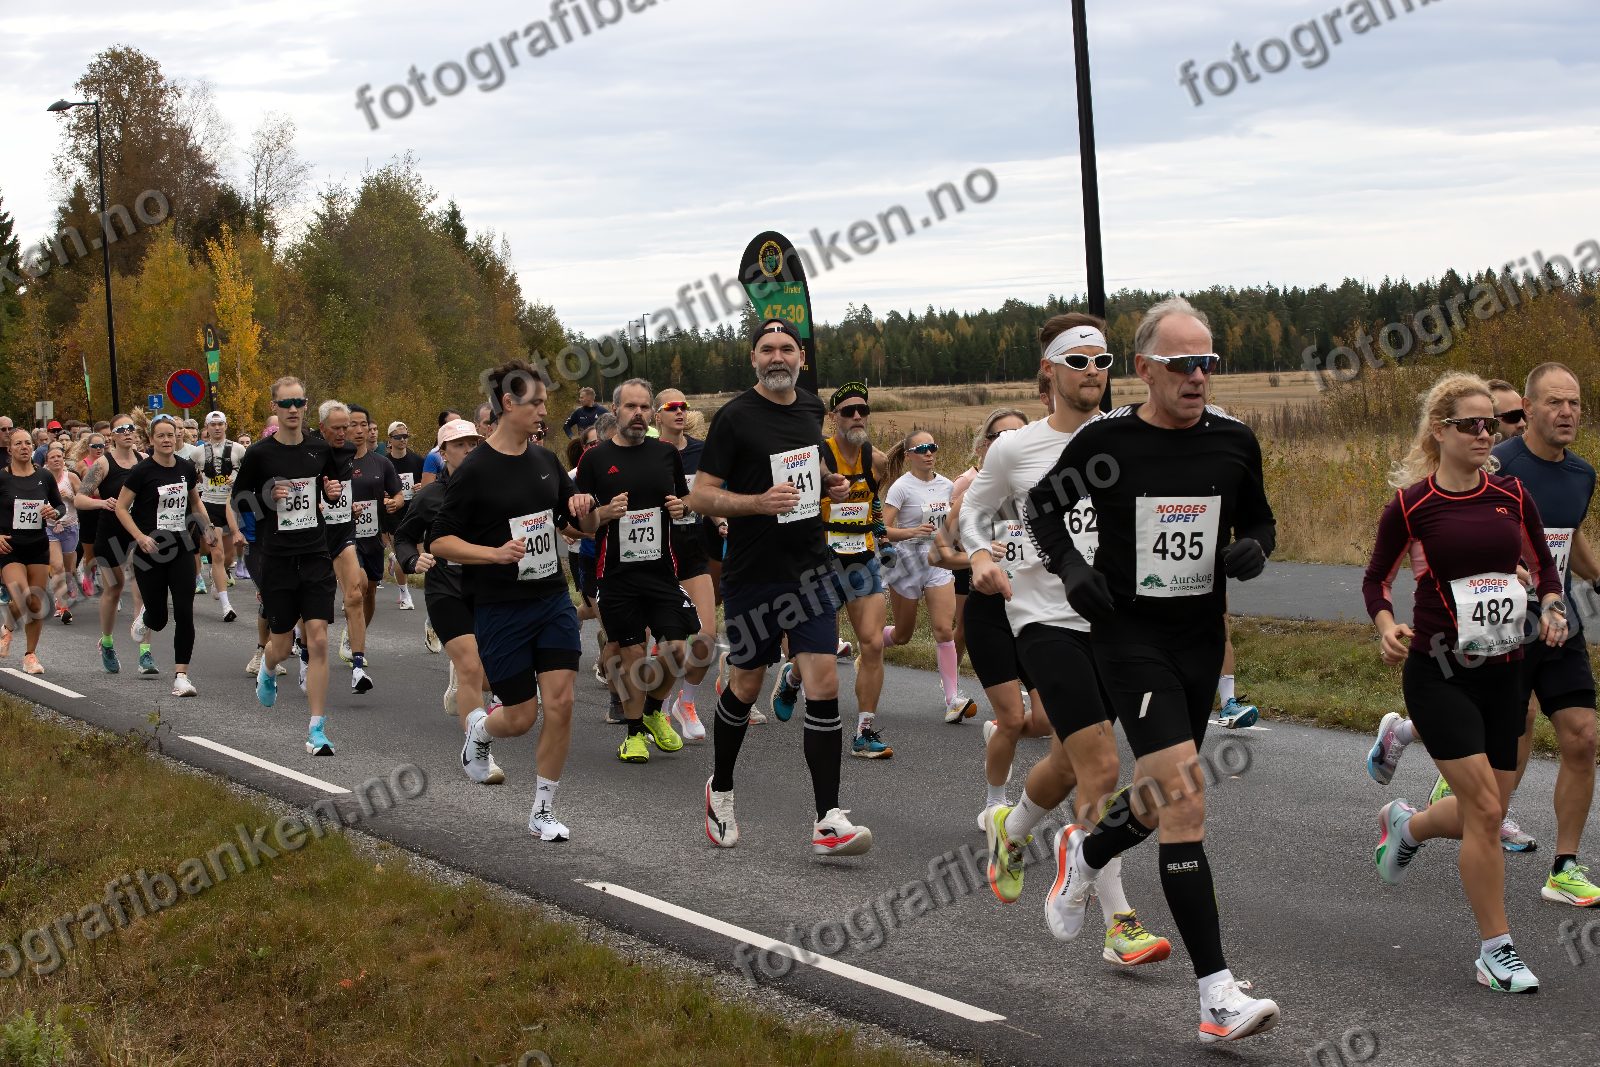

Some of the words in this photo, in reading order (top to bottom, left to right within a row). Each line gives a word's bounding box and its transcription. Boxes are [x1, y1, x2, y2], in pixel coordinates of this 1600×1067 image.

[162, 496, 186, 509] 1012
[285, 495, 309, 511] 565
[1156, 504, 1207, 514] NORGES
[19, 512, 38, 523] 542
[1160, 513, 1199, 523] LØPET
[628, 527, 655, 543] 473
[526, 532, 550, 556] 400
[1152, 531, 1204, 561] 435
[1170, 573, 1212, 584] Aurskog
[1466, 578, 1509, 588] NORGES
[1474, 585, 1505, 595] LØPET
[1472, 597, 1514, 627] 482
[1166, 860, 1199, 871] SELECT
